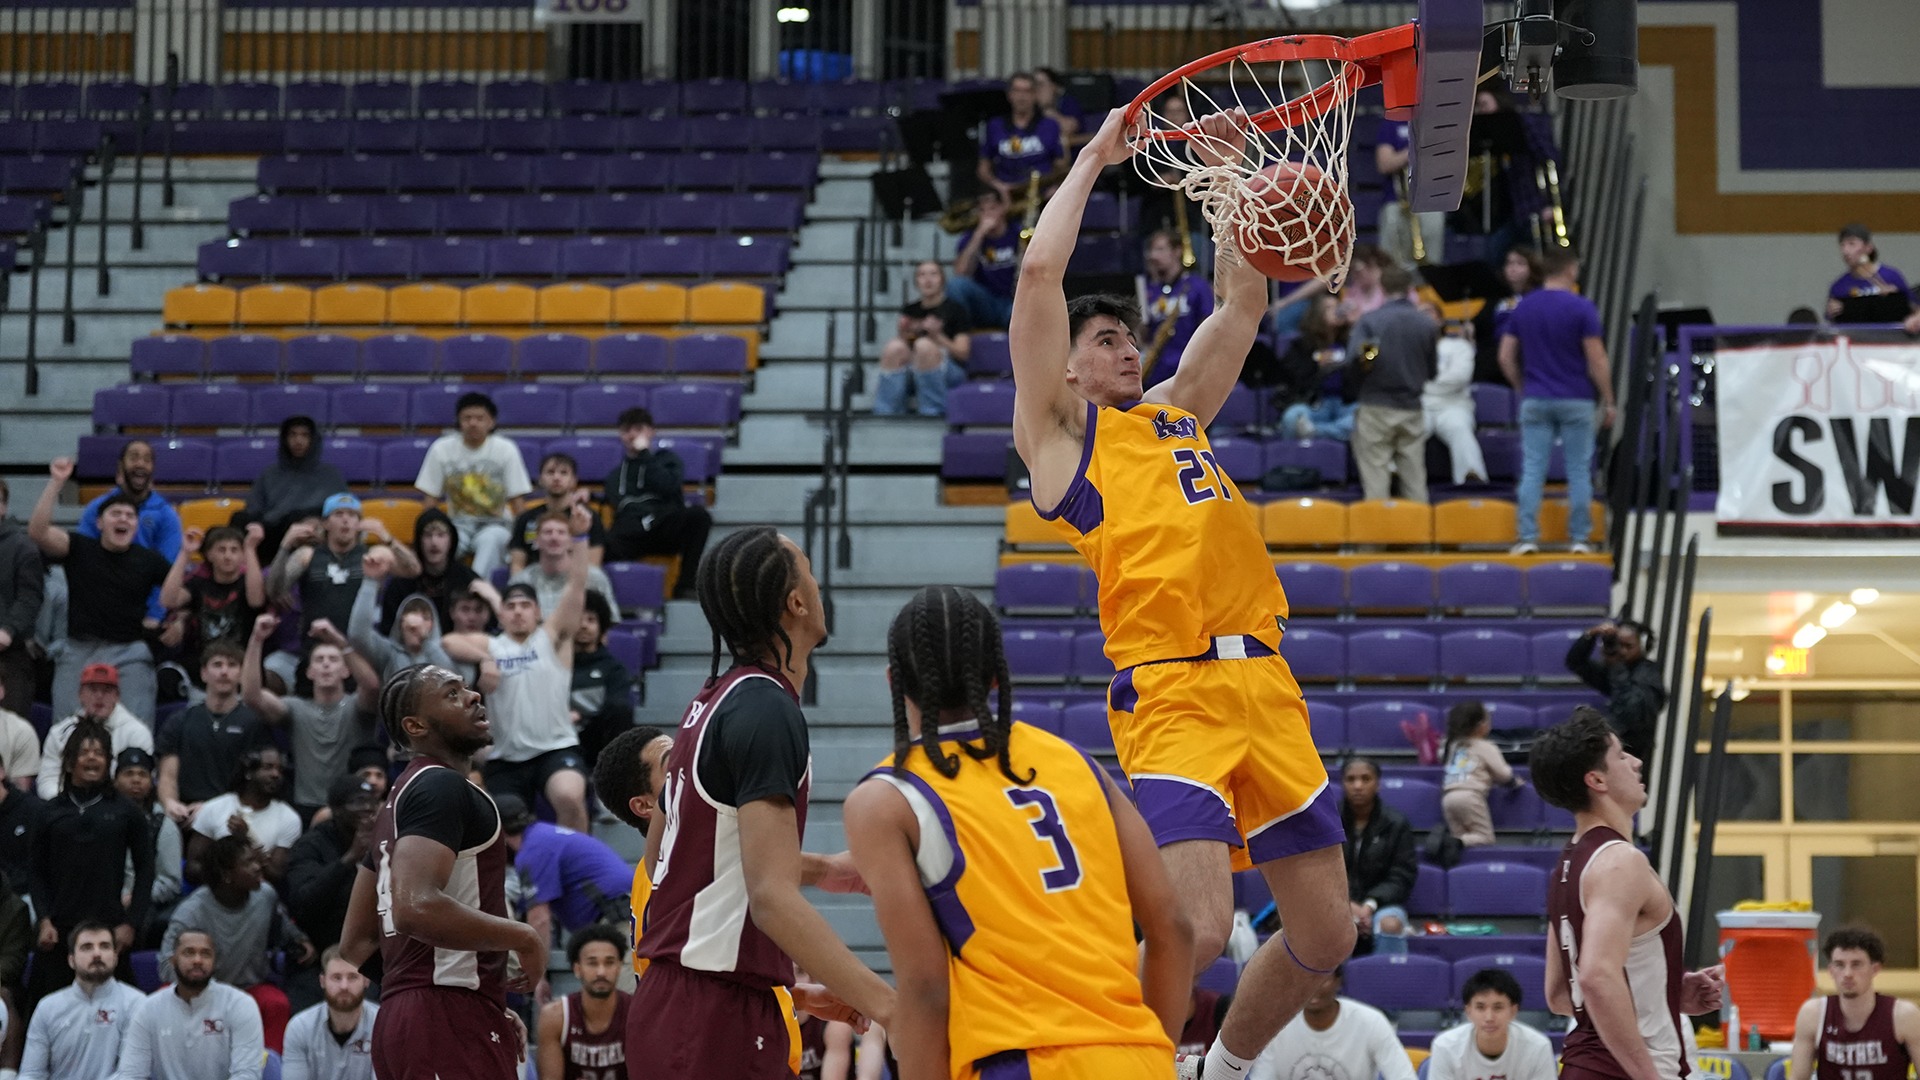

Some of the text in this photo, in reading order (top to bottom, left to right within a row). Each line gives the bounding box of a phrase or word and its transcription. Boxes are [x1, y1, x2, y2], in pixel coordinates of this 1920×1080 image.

[1171, 447, 1232, 506] 21
[1771, 416, 1920, 515] SW
[1002, 784, 1084, 894] 3
[1826, 1041, 1888, 1065] BETHEL
